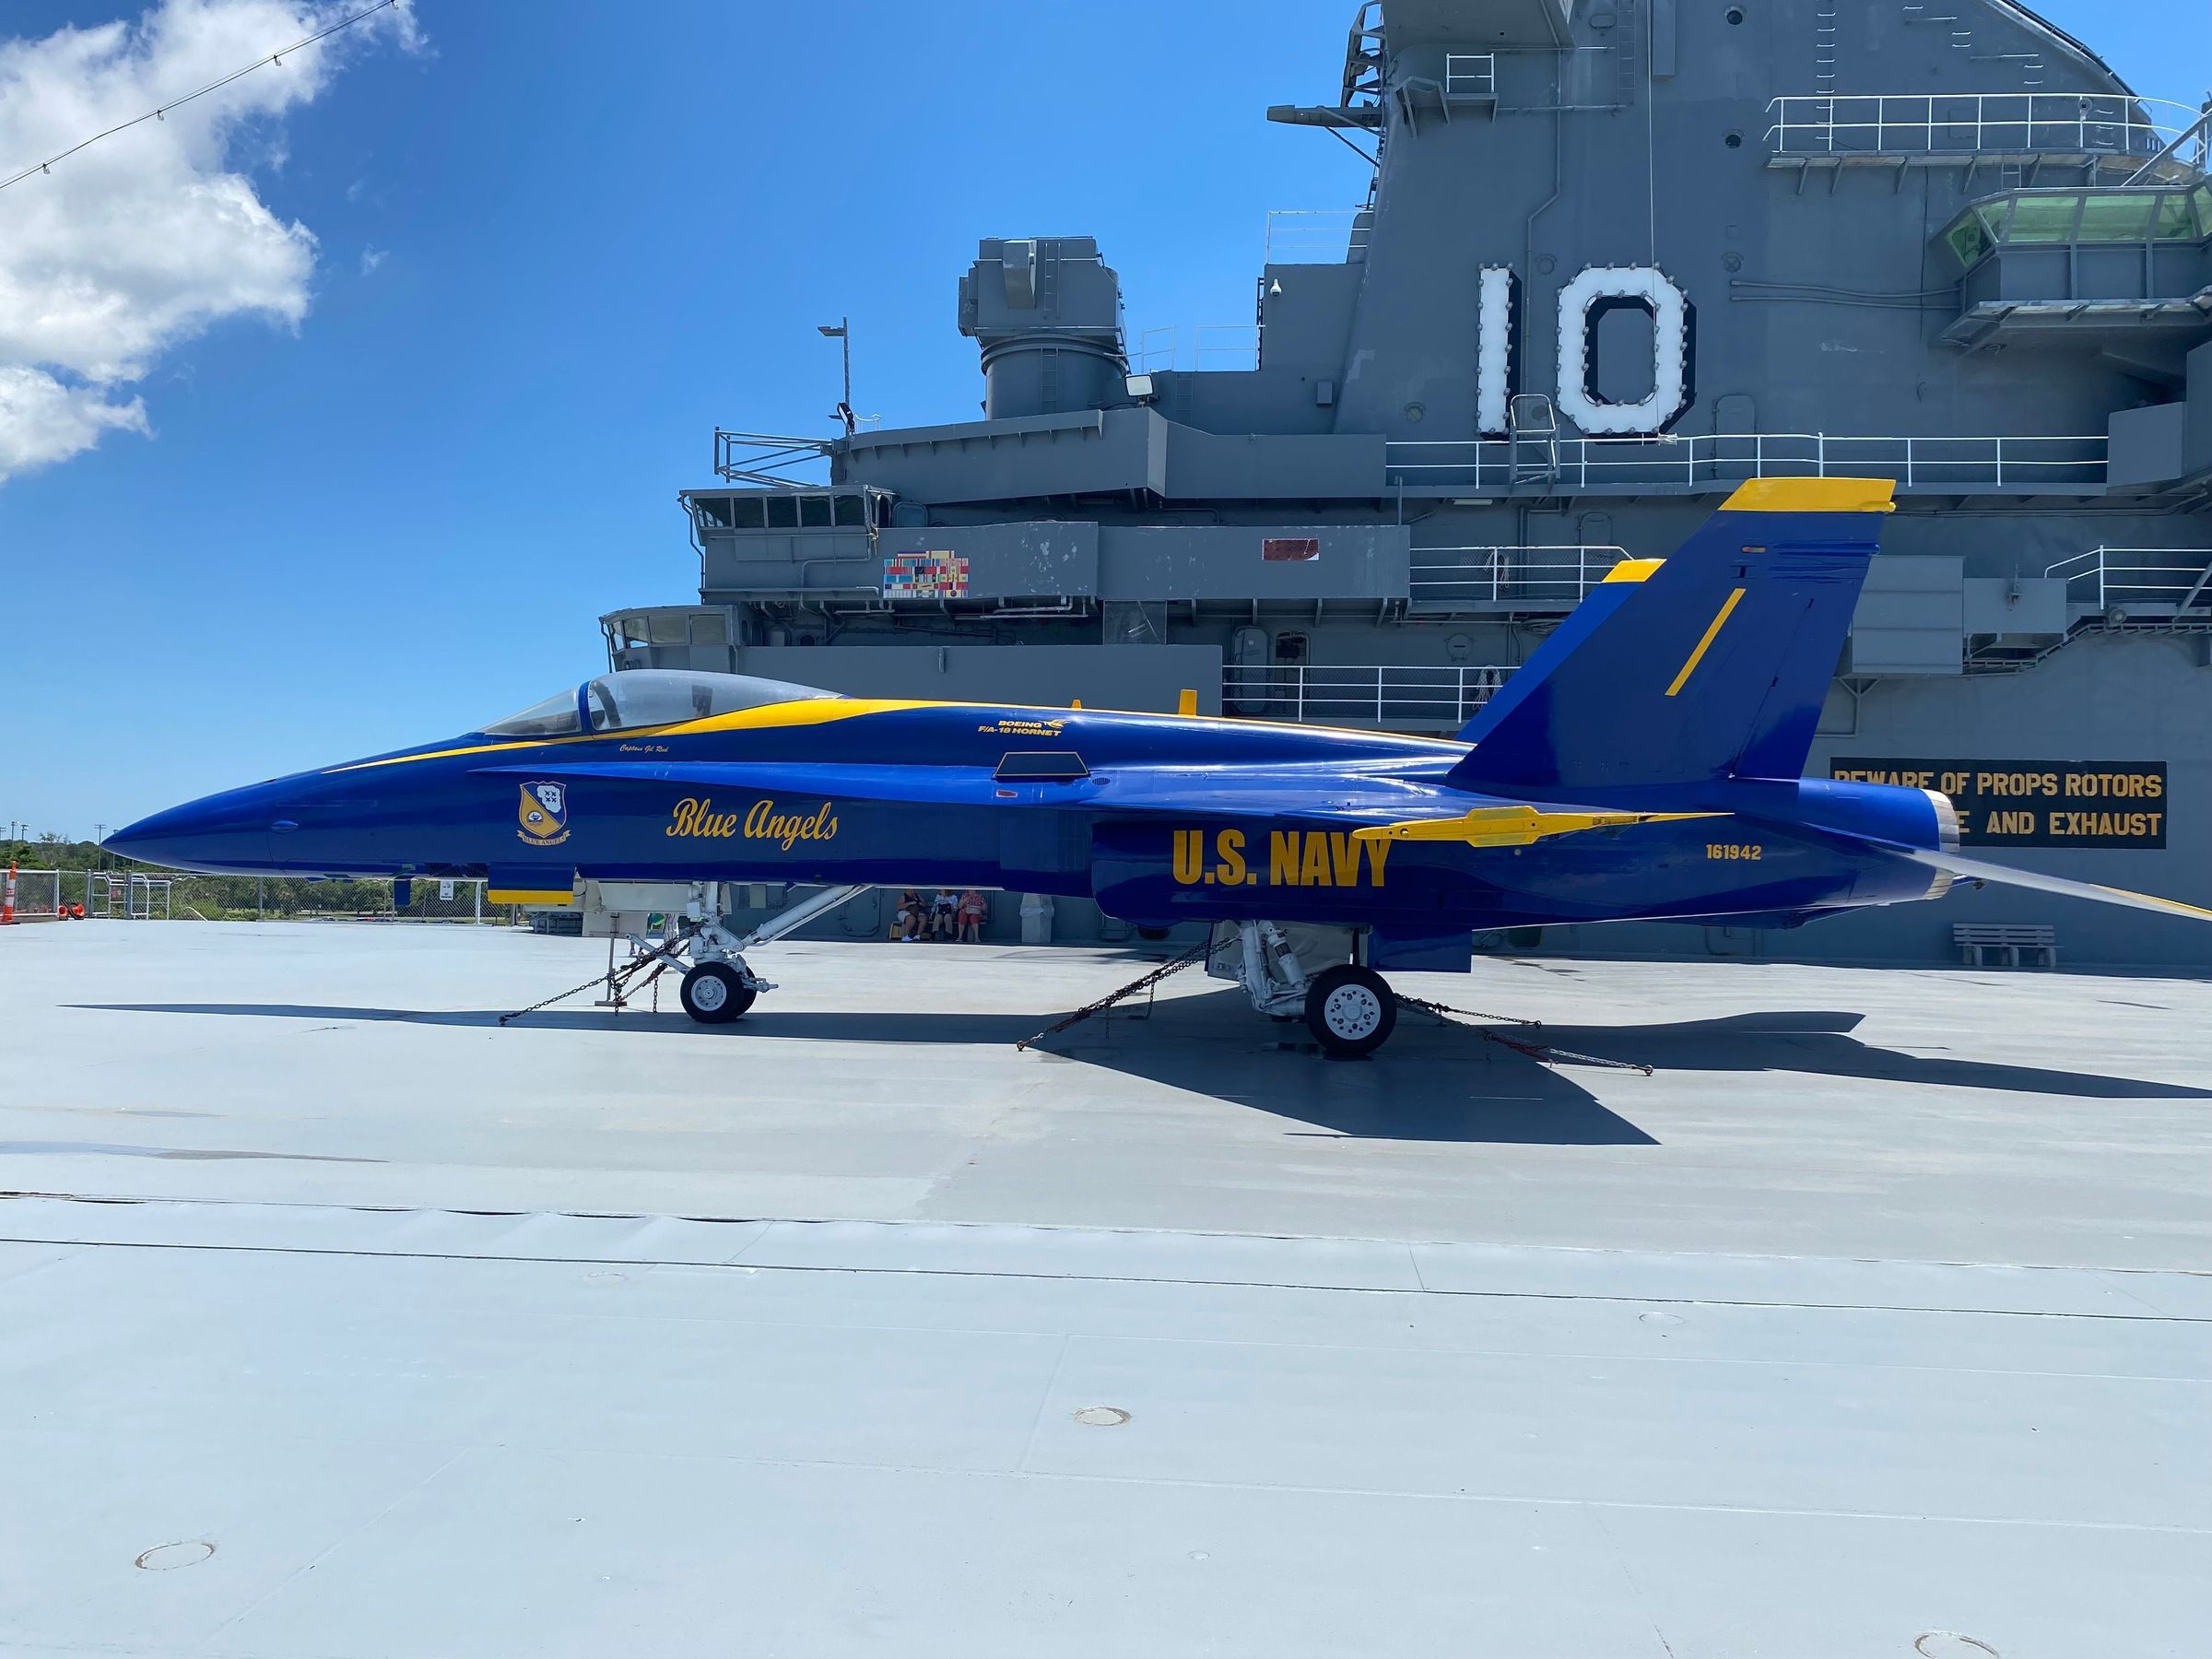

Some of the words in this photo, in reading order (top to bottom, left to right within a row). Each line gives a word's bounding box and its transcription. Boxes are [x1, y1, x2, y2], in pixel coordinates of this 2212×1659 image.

[1477, 263, 1696, 439] 10
[1012, 727, 1062, 736] HORNET
[1940, 771, 1970, 795] OF
[1977, 772, 2058, 796] PROPS
[2065, 773, 2162, 797] ROTORS
[665, 797, 738, 837] Blue
[744, 799, 839, 852] Angels
[1986, 811, 2035, 834] AND
[2049, 812, 2162, 836] EXHAUST
[523, 837, 540, 845] BLUE
[1706, 844, 1762, 861] 161942
[1172, 829, 1257, 886] U.S.
[1270, 830, 1393, 887] NAVY
